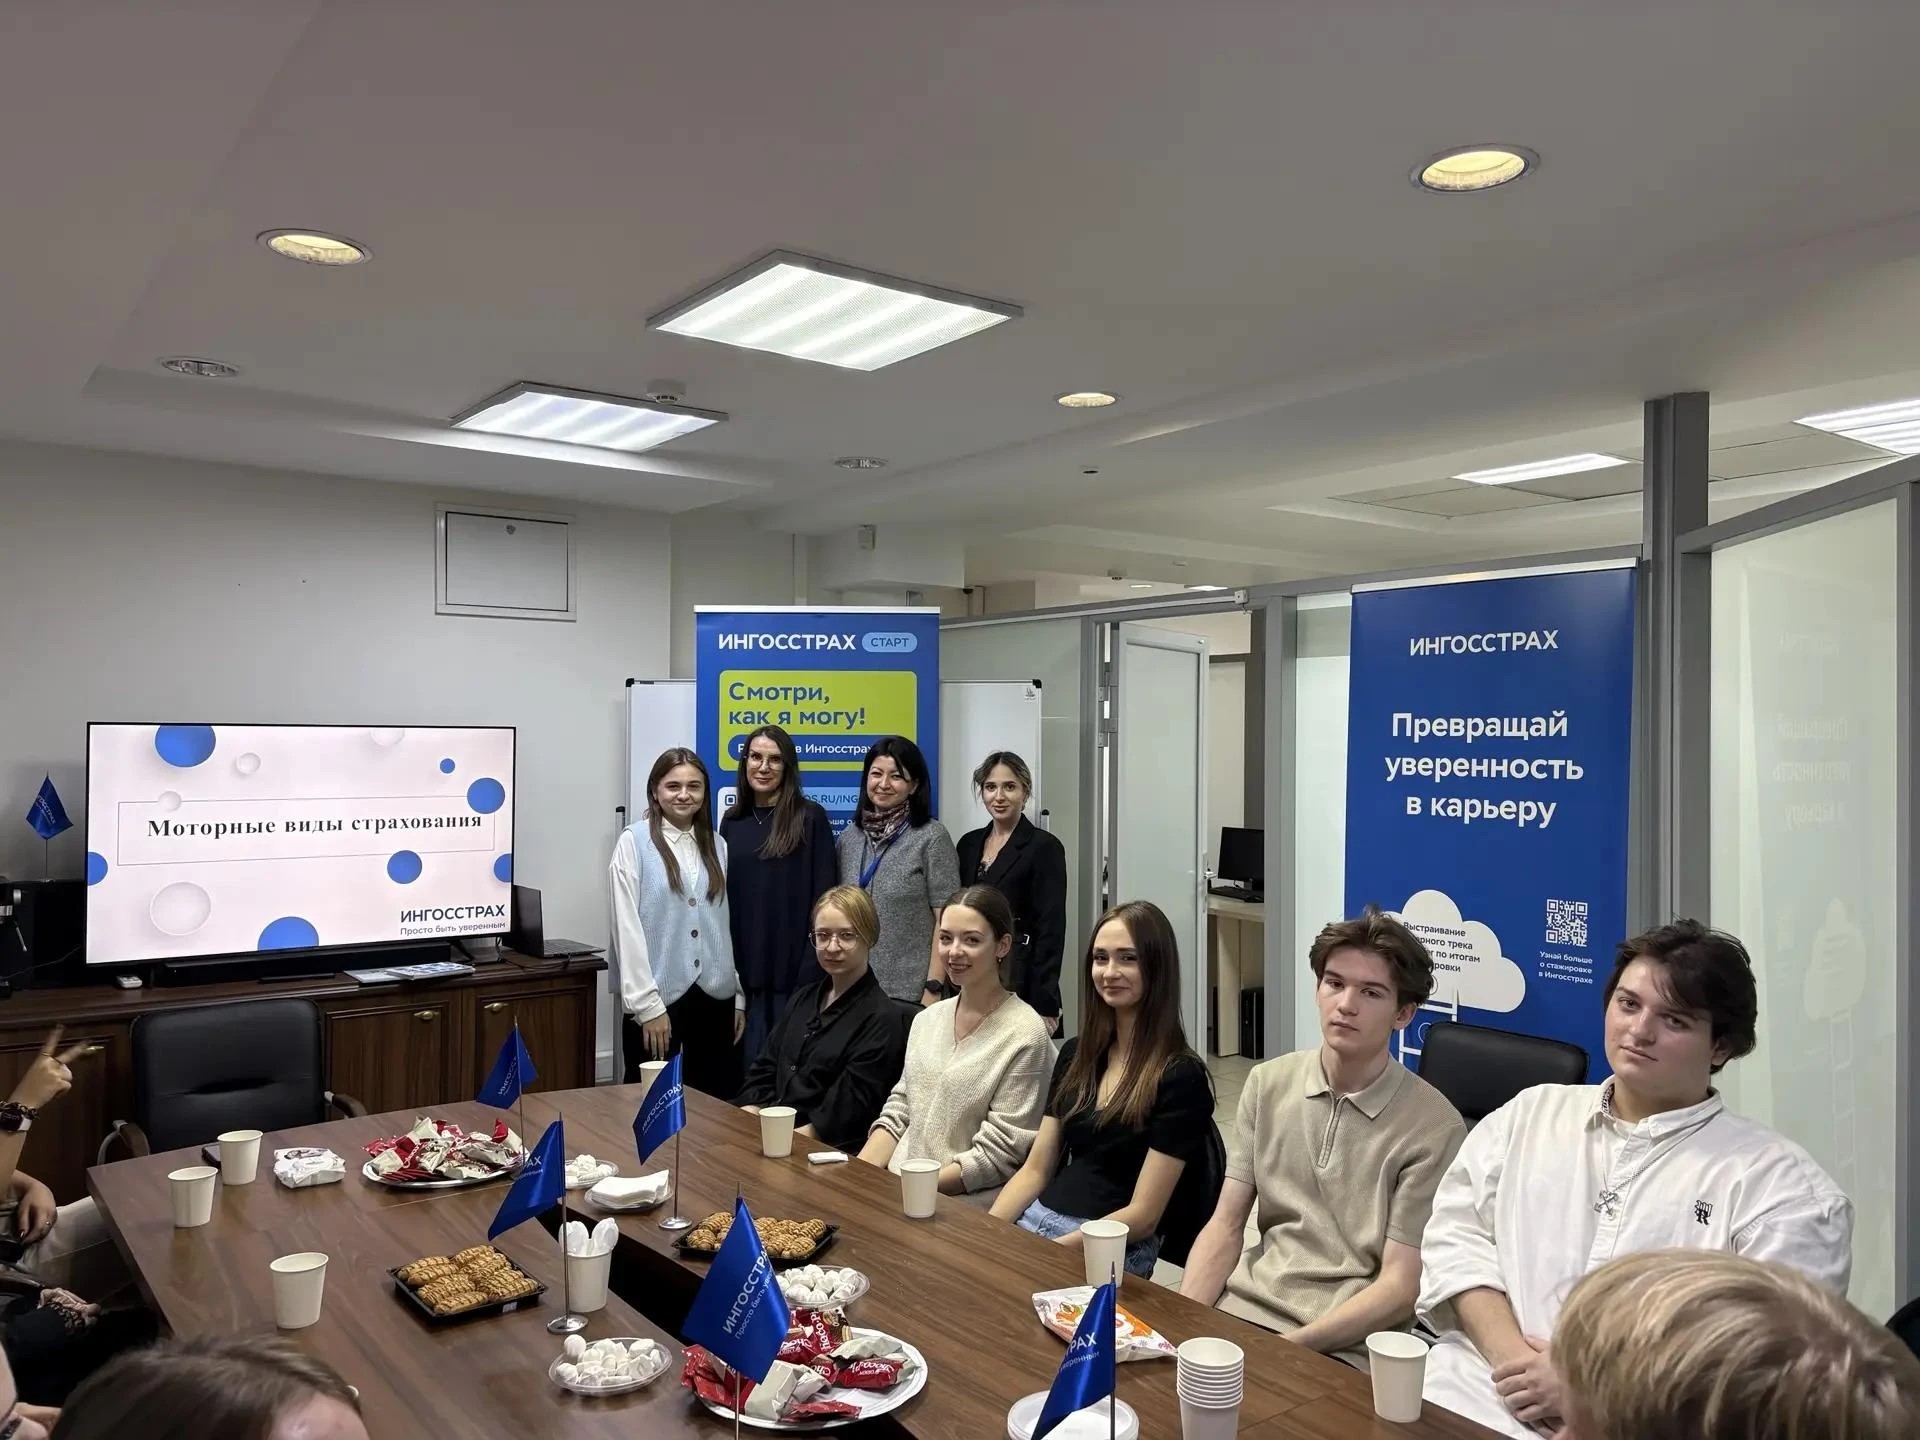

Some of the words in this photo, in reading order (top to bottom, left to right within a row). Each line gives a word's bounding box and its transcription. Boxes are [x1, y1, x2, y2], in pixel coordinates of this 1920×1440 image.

[718, 633, 856, 650] ИНГОССТРАХ
[870, 637, 909, 648] СТАРТ
[1410, 630, 1559, 656] ИНГОССТРАХ
[729, 682, 830, 705] Смотри,
[729, 710, 770, 725] как
[778, 711, 791, 725] я
[800, 708, 865, 730] могу!
[1392, 710, 1568, 743] Превращай
[1385, 756, 1584, 783] уверенность
[1406, 796, 1422, 816] в
[1431, 797, 1556, 829] карьеру
[148, 819, 276, 840] Моторные
[285, 818, 343, 834] виды
[351, 815, 483, 838] страхования
[401, 904, 505, 923] ИНГОССТРАХ
[400, 927, 433, 937] Просто
[436, 925, 457, 933] быть
[459, 922, 506, 933] уверенным
[1403, 921, 1466, 937] Выстраивание
[1447, 940, 1473, 950] трека
[1436, 950, 1447, 959] по
[1449, 952, 1481, 963] итогам
[1539, 951, 1562, 960] Узнай
[1563, 953, 1593, 964] больше
[1546, 962, 1593, 974] стажировке
[1544, 971, 1593, 984] Ингосстрахе
